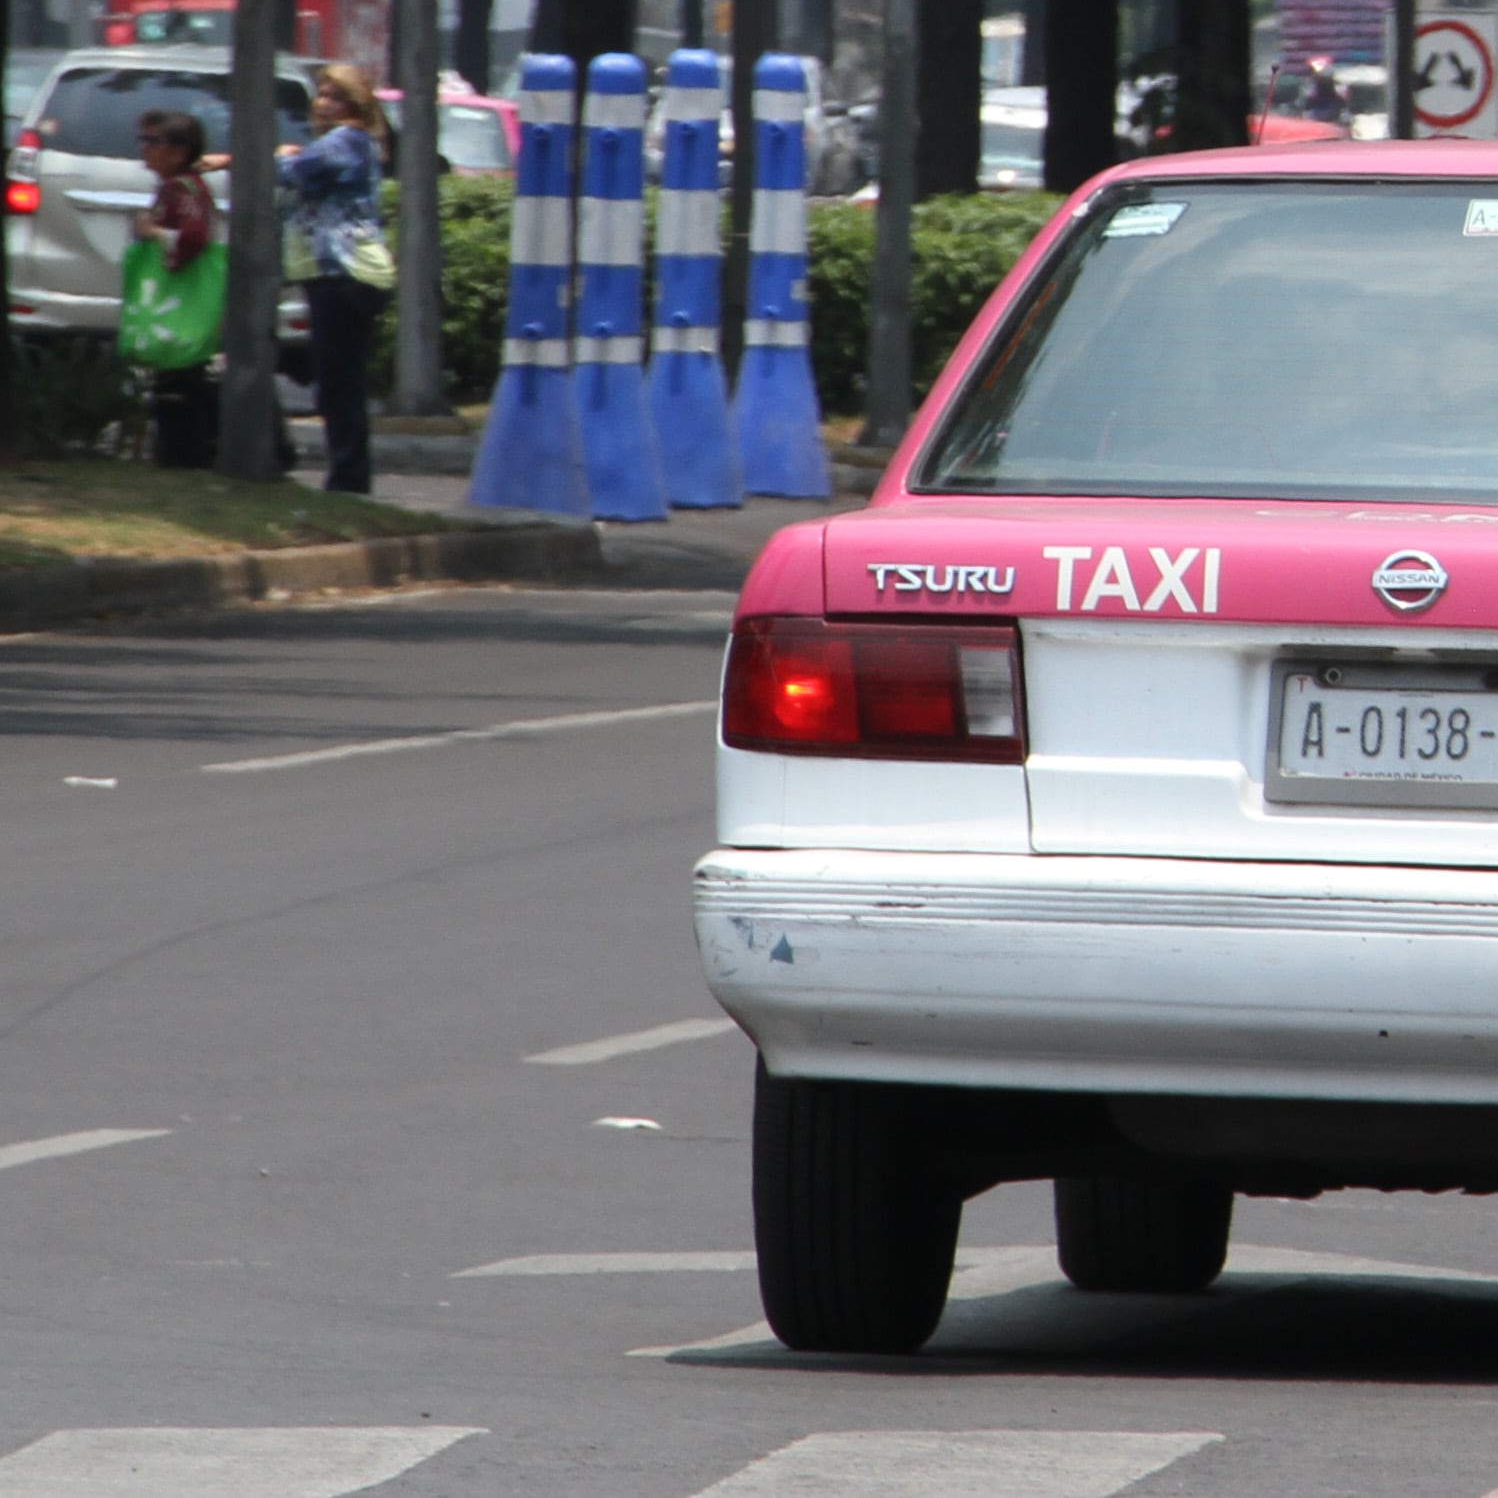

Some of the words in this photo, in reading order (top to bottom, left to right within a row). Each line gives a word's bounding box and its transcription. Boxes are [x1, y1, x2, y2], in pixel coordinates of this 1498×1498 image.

[867, 563, 1015, 593] TSURU
[1043, 546, 1221, 613] TAXI
[1379, 574, 1440, 584] NISSAN
